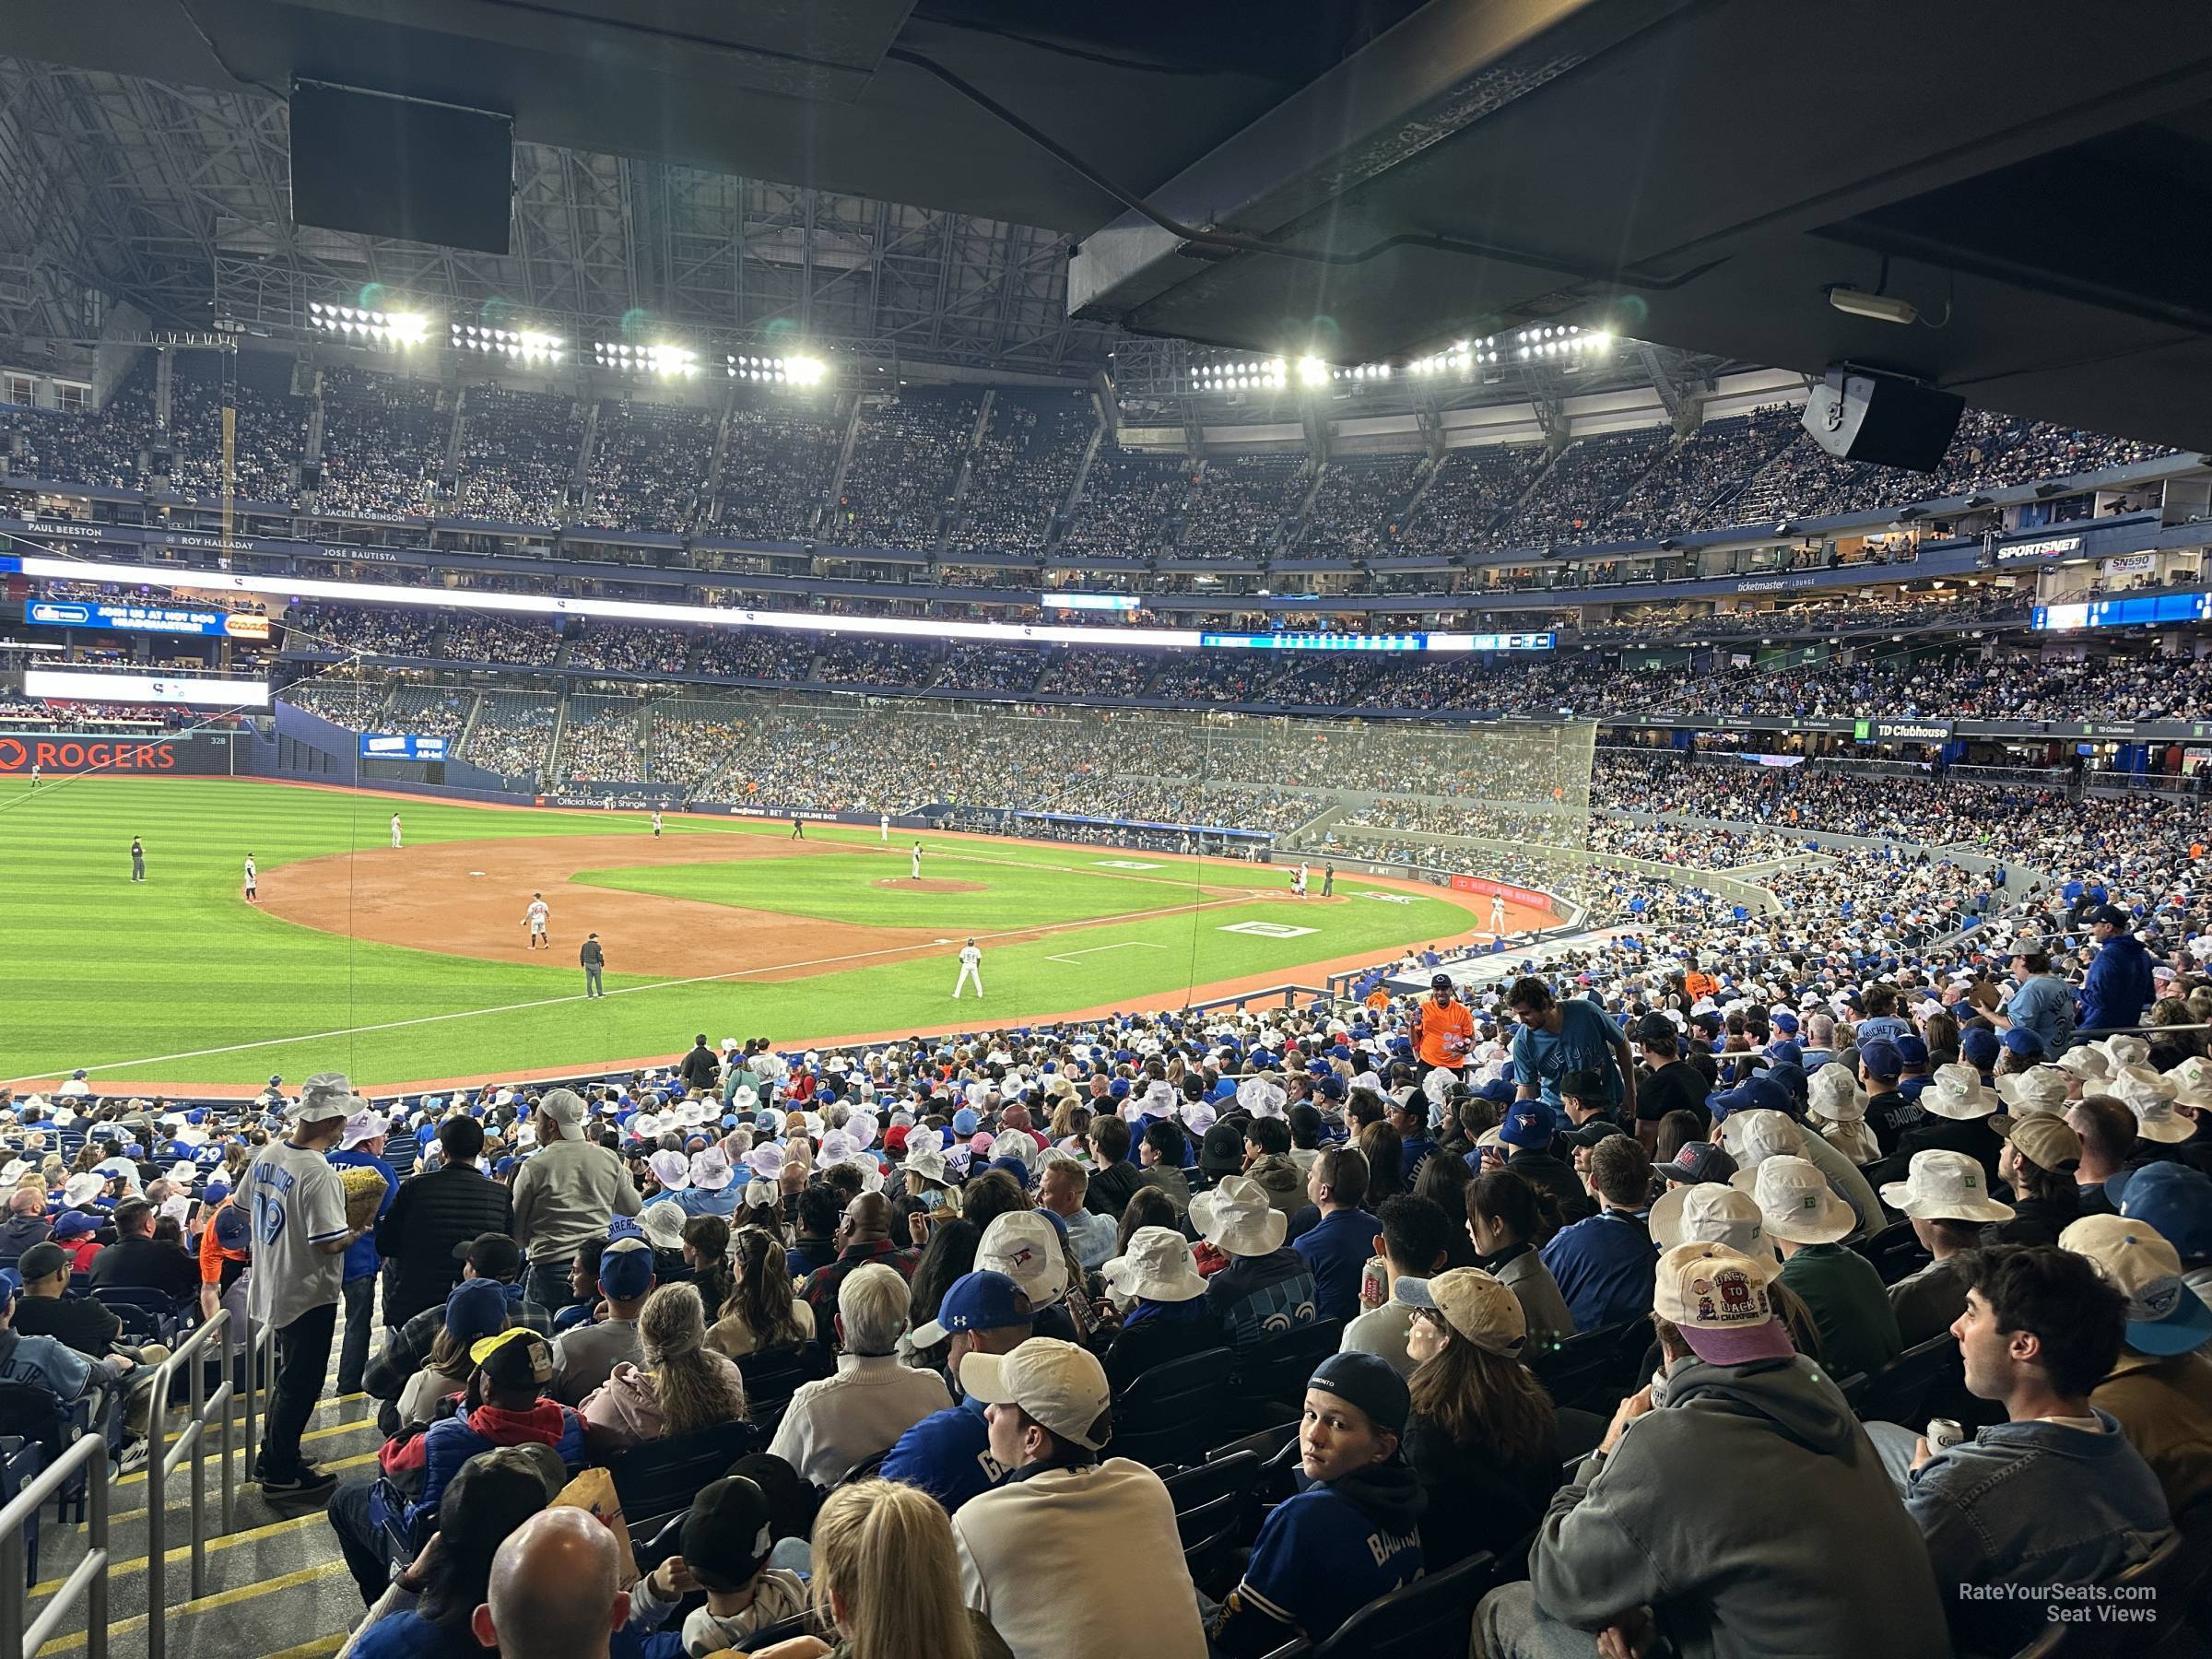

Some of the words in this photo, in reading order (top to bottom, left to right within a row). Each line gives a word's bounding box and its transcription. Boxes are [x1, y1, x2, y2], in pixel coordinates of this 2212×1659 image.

[324, 508, 356, 519] JACKIE
[358, 511, 406, 523] ROBINSON
[28, 523, 53, 533] PAUL
[56, 525, 102, 537] BEESTON
[182, 536, 202, 546] ROY
[205, 538, 253, 550] HALLADAY
[1997, 537, 2081, 559] SPORTSNET
[323, 547, 347, 558] JOSÉ
[351, 550, 396, 561] BAUTISTA
[2112, 555, 2149, 569] SN590
[1737, 580, 1784, 592] ticketmaster
[1792, 578, 1815, 587] LOUNGE
[98, 607, 127, 618] JOIN
[130, 609, 146, 619] US
[148, 610, 164, 620] AT
[1878, 725, 1892, 736] TD
[1893, 724, 1947, 737] Clubhouse
[211, 736, 226, 745] 328
[37, 742, 175, 768] ROGERS
[557, 797, 585, 806] Official
[618, 799, 647, 810] Shingle
[823, 812, 837, 820] BOX
[195, 1147, 222, 1162] 29
[253, 1191, 286, 1246] 19
[1714, 1271, 1749, 1288] BACK
[1728, 1288, 1743, 1297] TO
[1721, 1298, 1756, 1313] BACK
